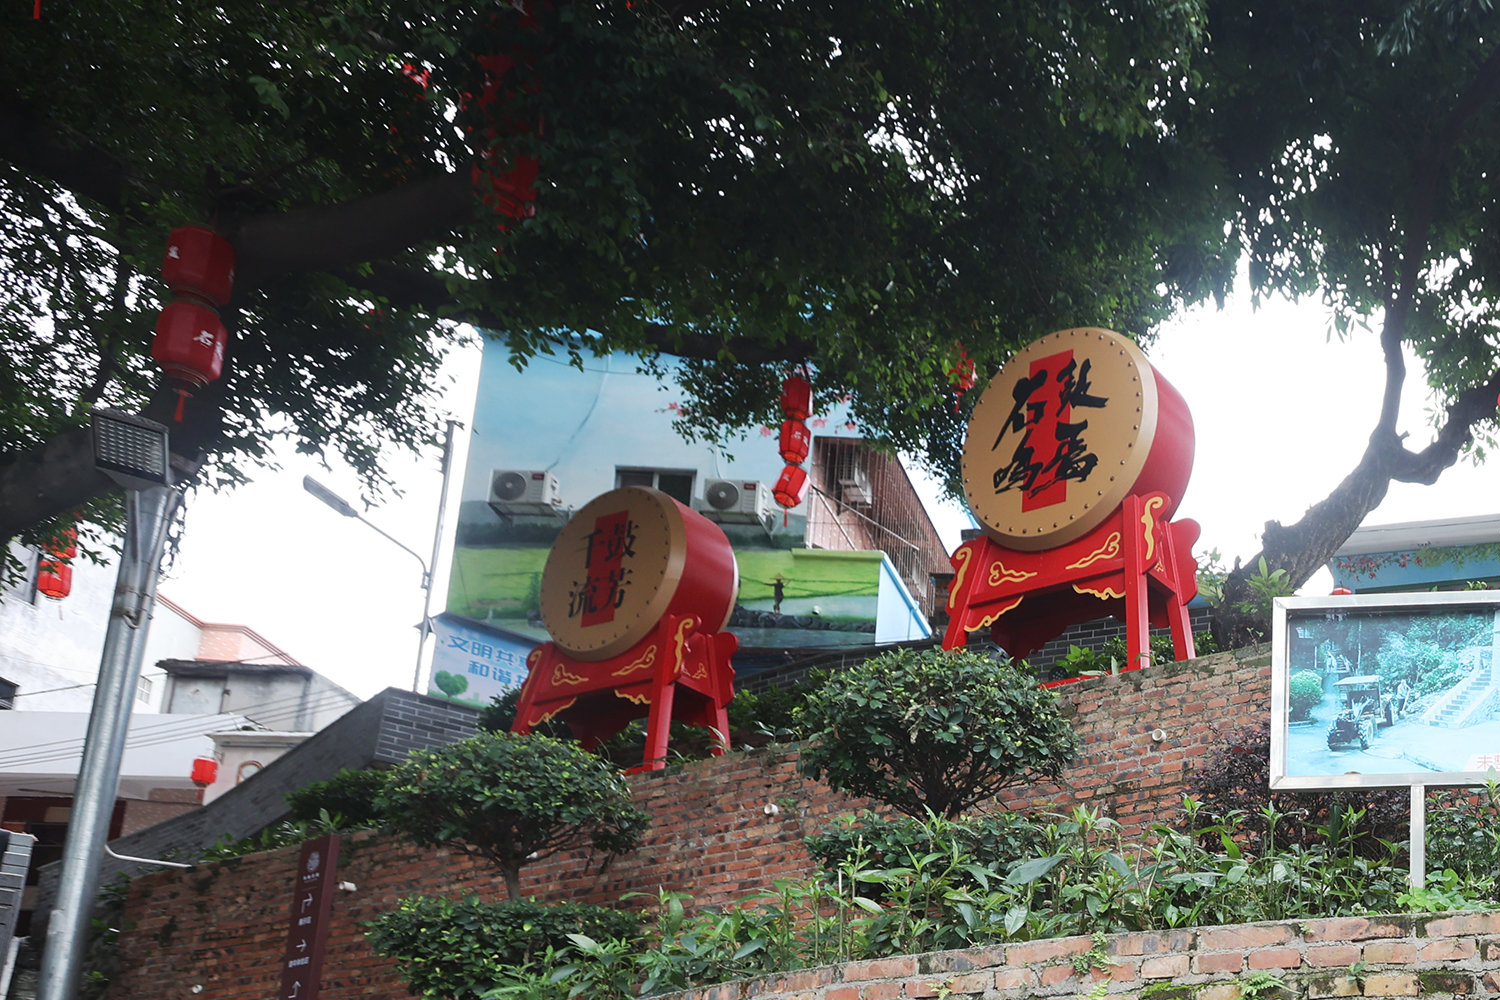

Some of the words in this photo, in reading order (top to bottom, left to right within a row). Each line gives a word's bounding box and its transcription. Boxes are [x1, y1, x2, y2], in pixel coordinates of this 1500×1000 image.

[574, 519, 640, 569] 千鼓
[567, 567, 635, 619] 流芳
[447, 634, 528, 672] 文明共
